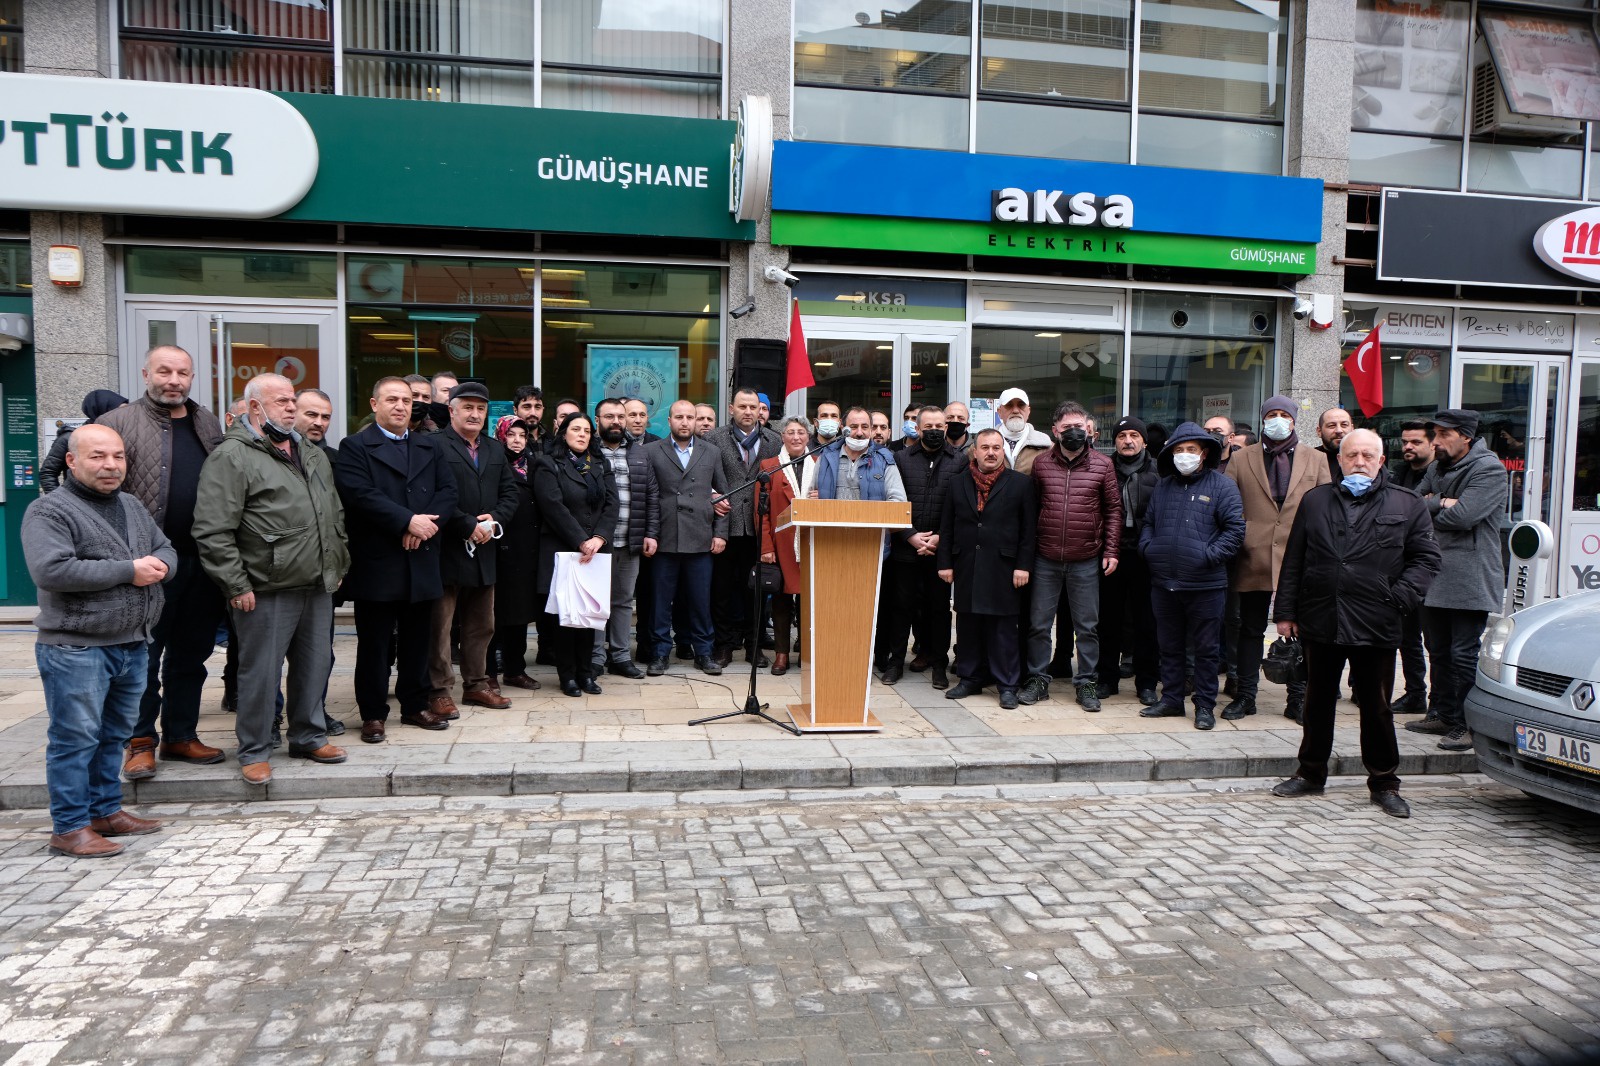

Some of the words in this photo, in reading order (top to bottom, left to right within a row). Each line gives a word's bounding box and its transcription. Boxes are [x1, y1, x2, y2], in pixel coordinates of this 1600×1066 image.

[0, 110, 234, 176] TTÜRK
[537, 154, 709, 189] GÜMÜŞHANE
[994, 187, 1134, 229] aksa
[988, 233, 1128, 254] ELEKTRİK
[1230, 247, 1306, 266] GÜMÜŞHANE
[853, 290, 906, 306] aksa
[1387, 311, 1446, 329] EKMEN
[1462, 316, 1510, 333] Penti
[1527, 320, 1565, 337] Belvü
[1512, 565, 1529, 613] TÜRK
[1527, 729, 1547, 752] 29
[1559, 737, 1591, 764] AAG
